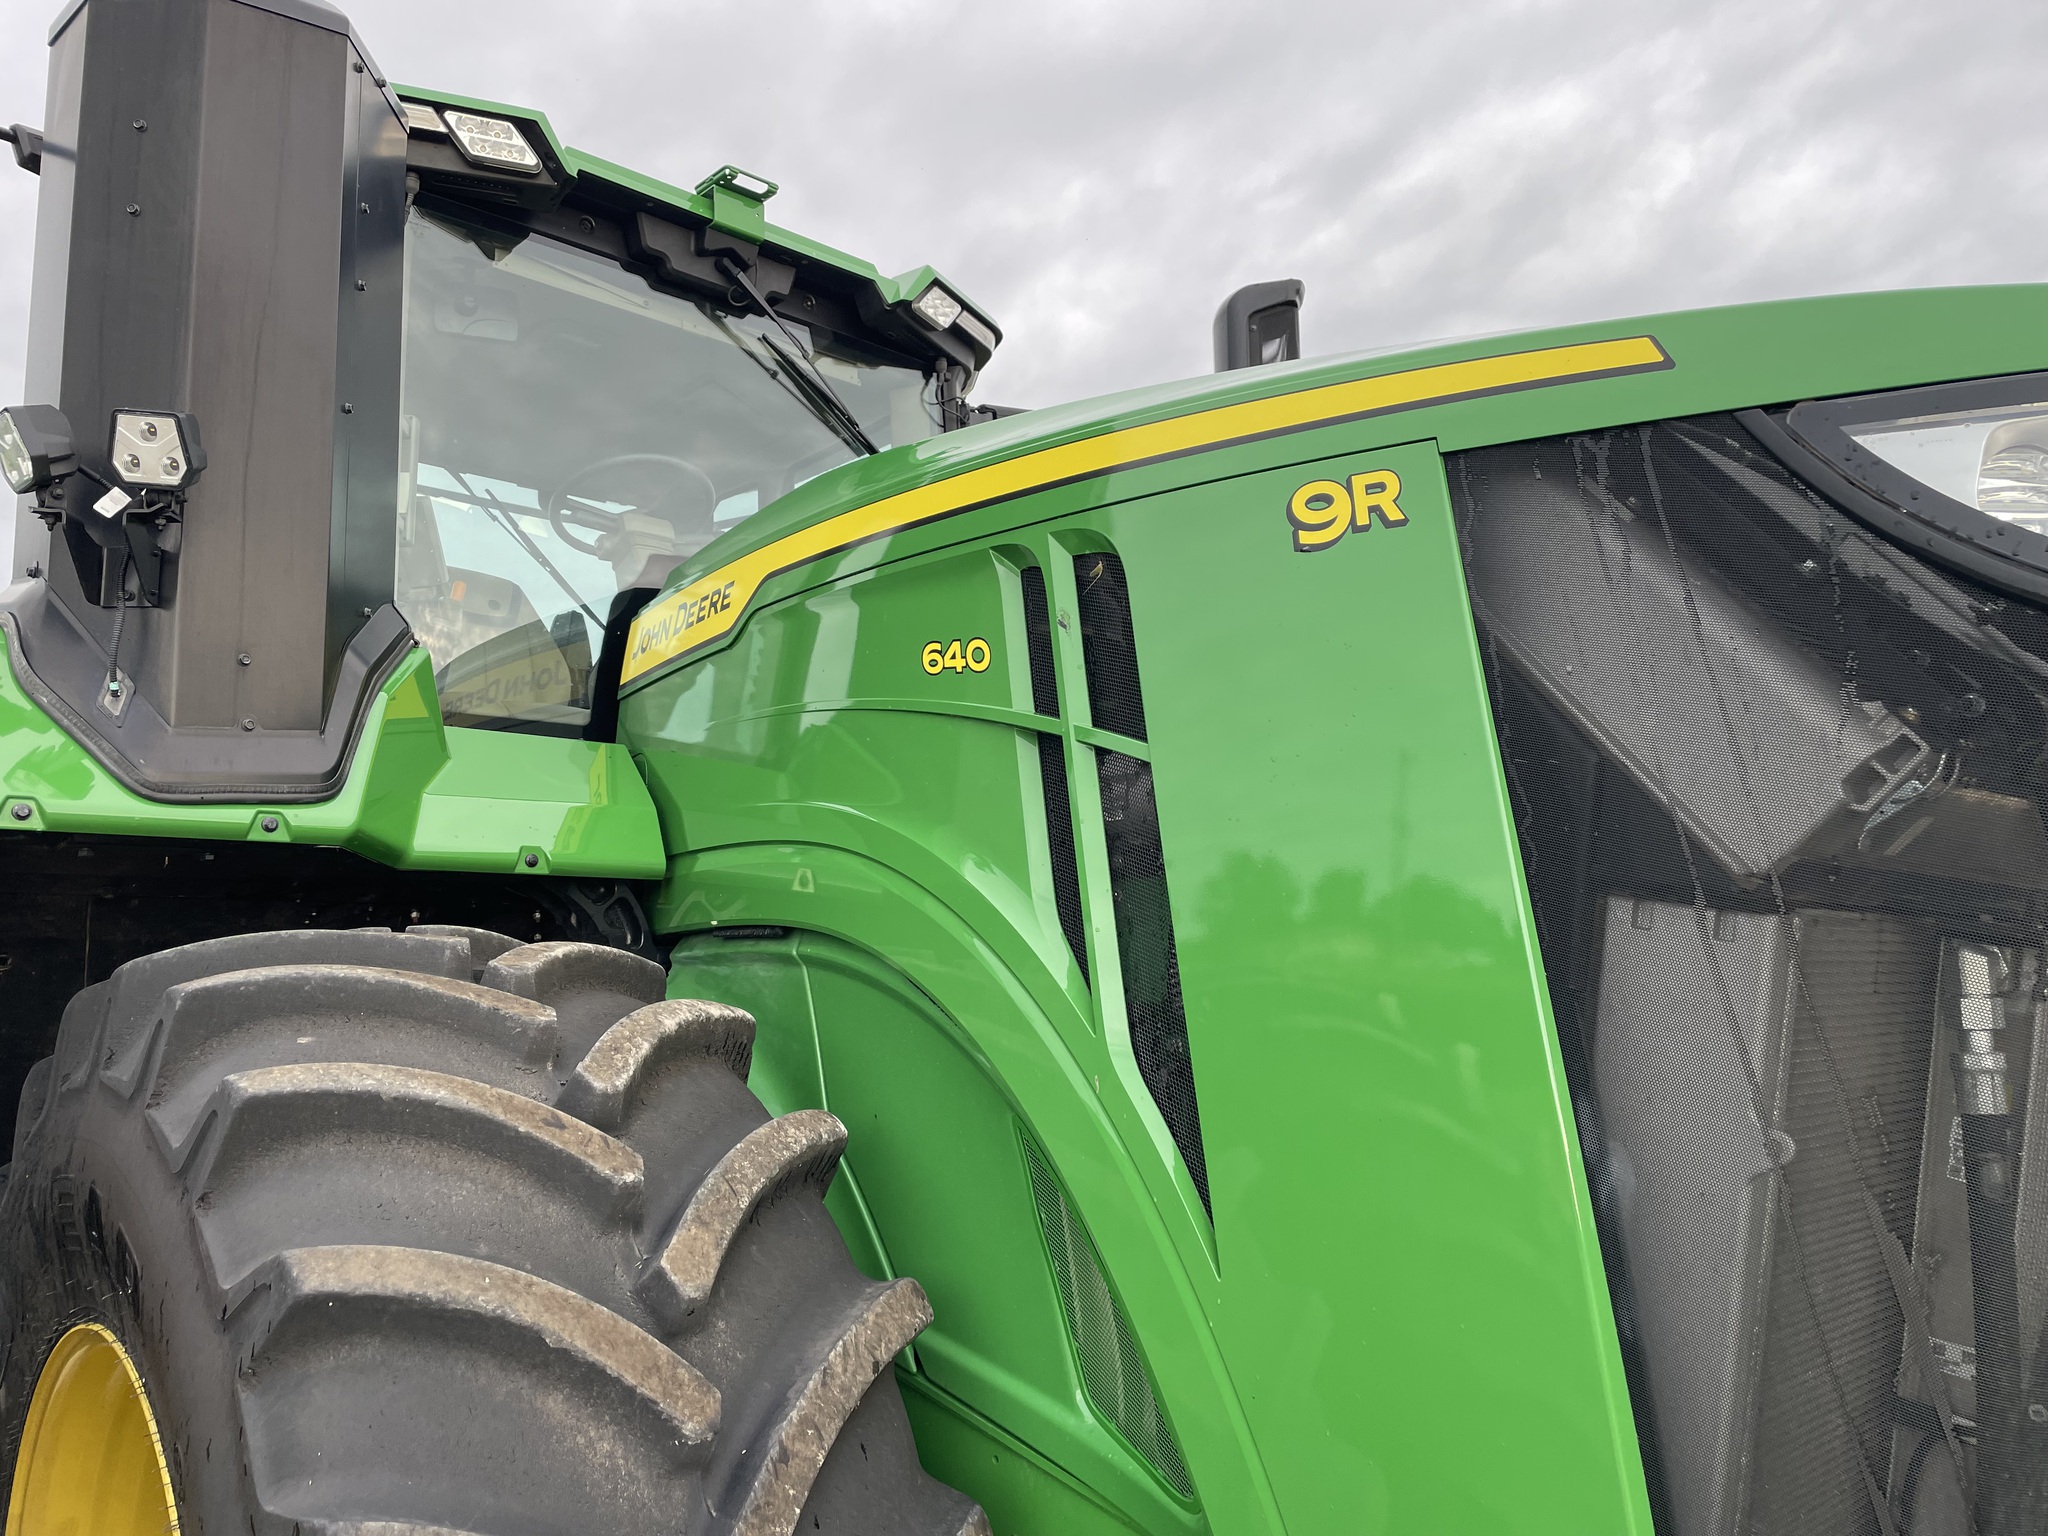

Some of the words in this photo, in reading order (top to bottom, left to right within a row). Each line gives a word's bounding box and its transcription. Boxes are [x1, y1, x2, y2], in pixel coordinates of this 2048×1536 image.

[1286, 469, 1410, 553] 9R
[631, 614, 673, 660] JOHN
[672, 580, 735, 637] DEERE
[921, 637, 991, 676] 640
